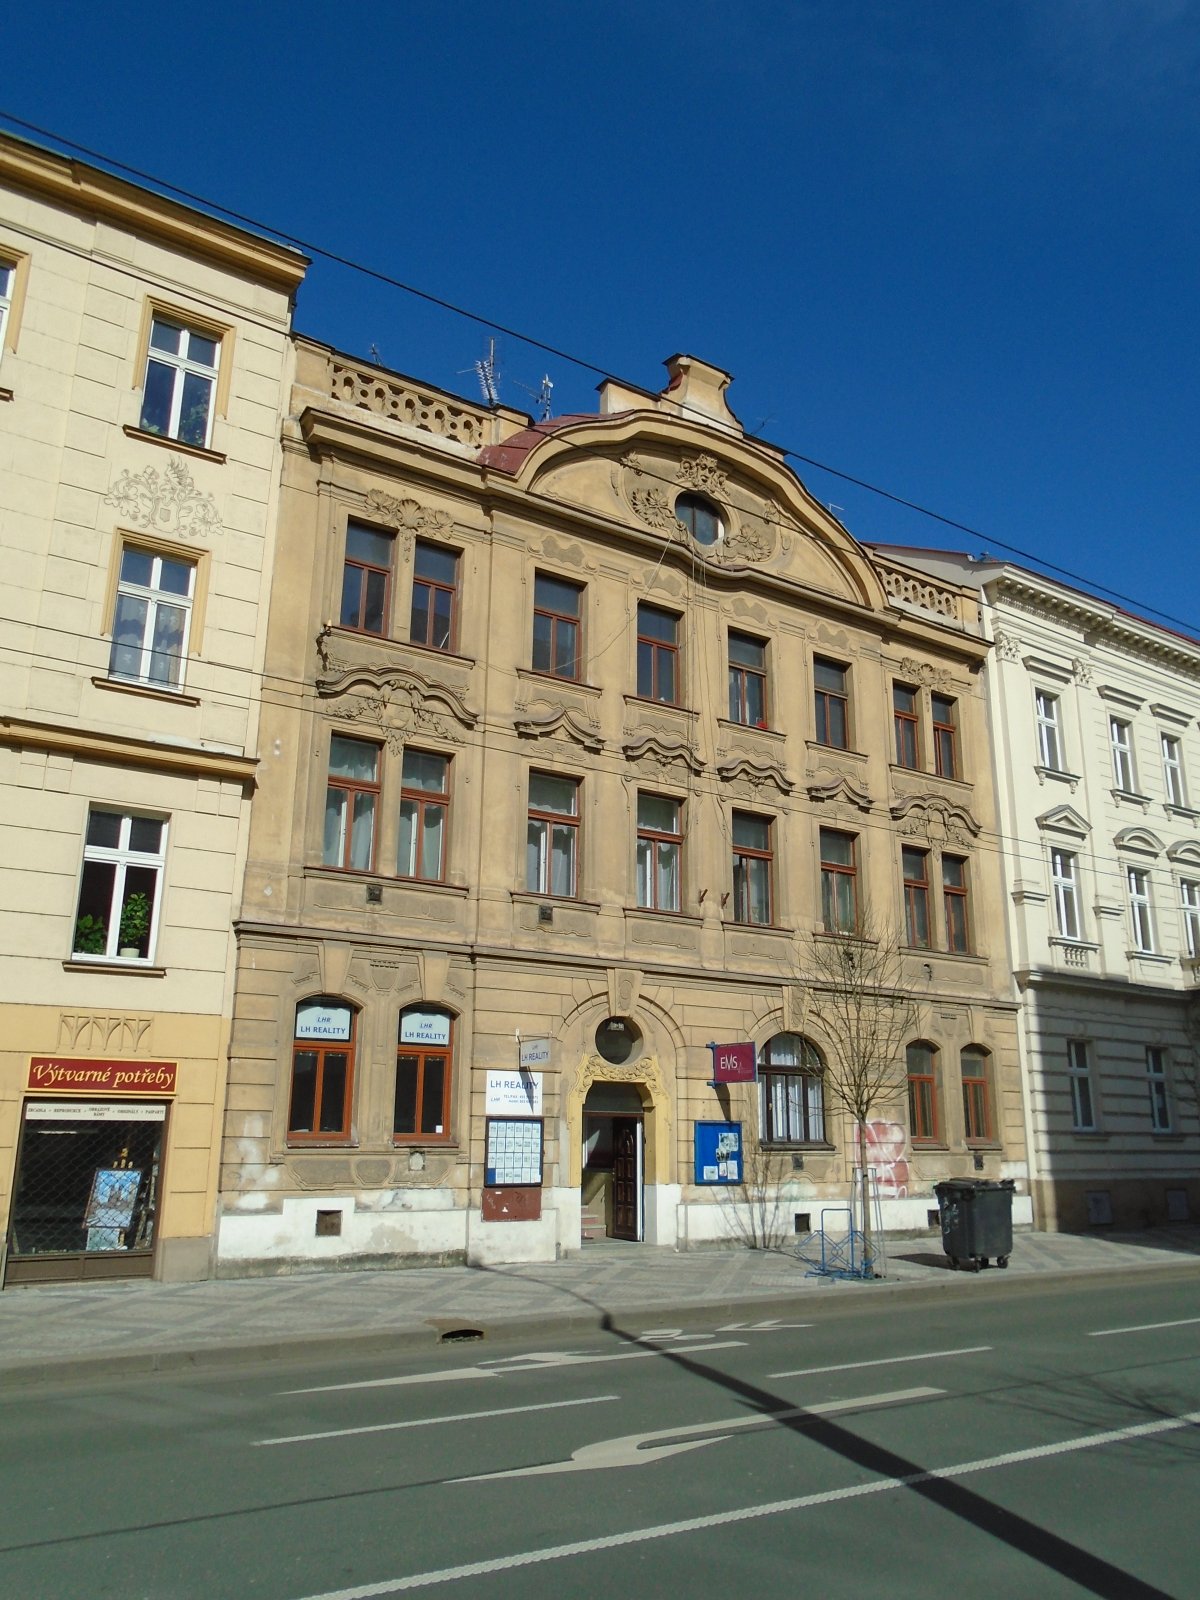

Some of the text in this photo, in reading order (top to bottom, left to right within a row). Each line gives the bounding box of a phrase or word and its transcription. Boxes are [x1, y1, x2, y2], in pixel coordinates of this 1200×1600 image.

[300, 1025, 346, 1035] LH REALITY
[416, 1032, 446, 1040] REALITY
[529, 1052, 548, 1061] REALITY
[719, 1053, 738, 1070] EMS
[33, 1063, 174, 1089] Výtvarné potřeby
[490, 1080, 539, 1090] LH REALITY
